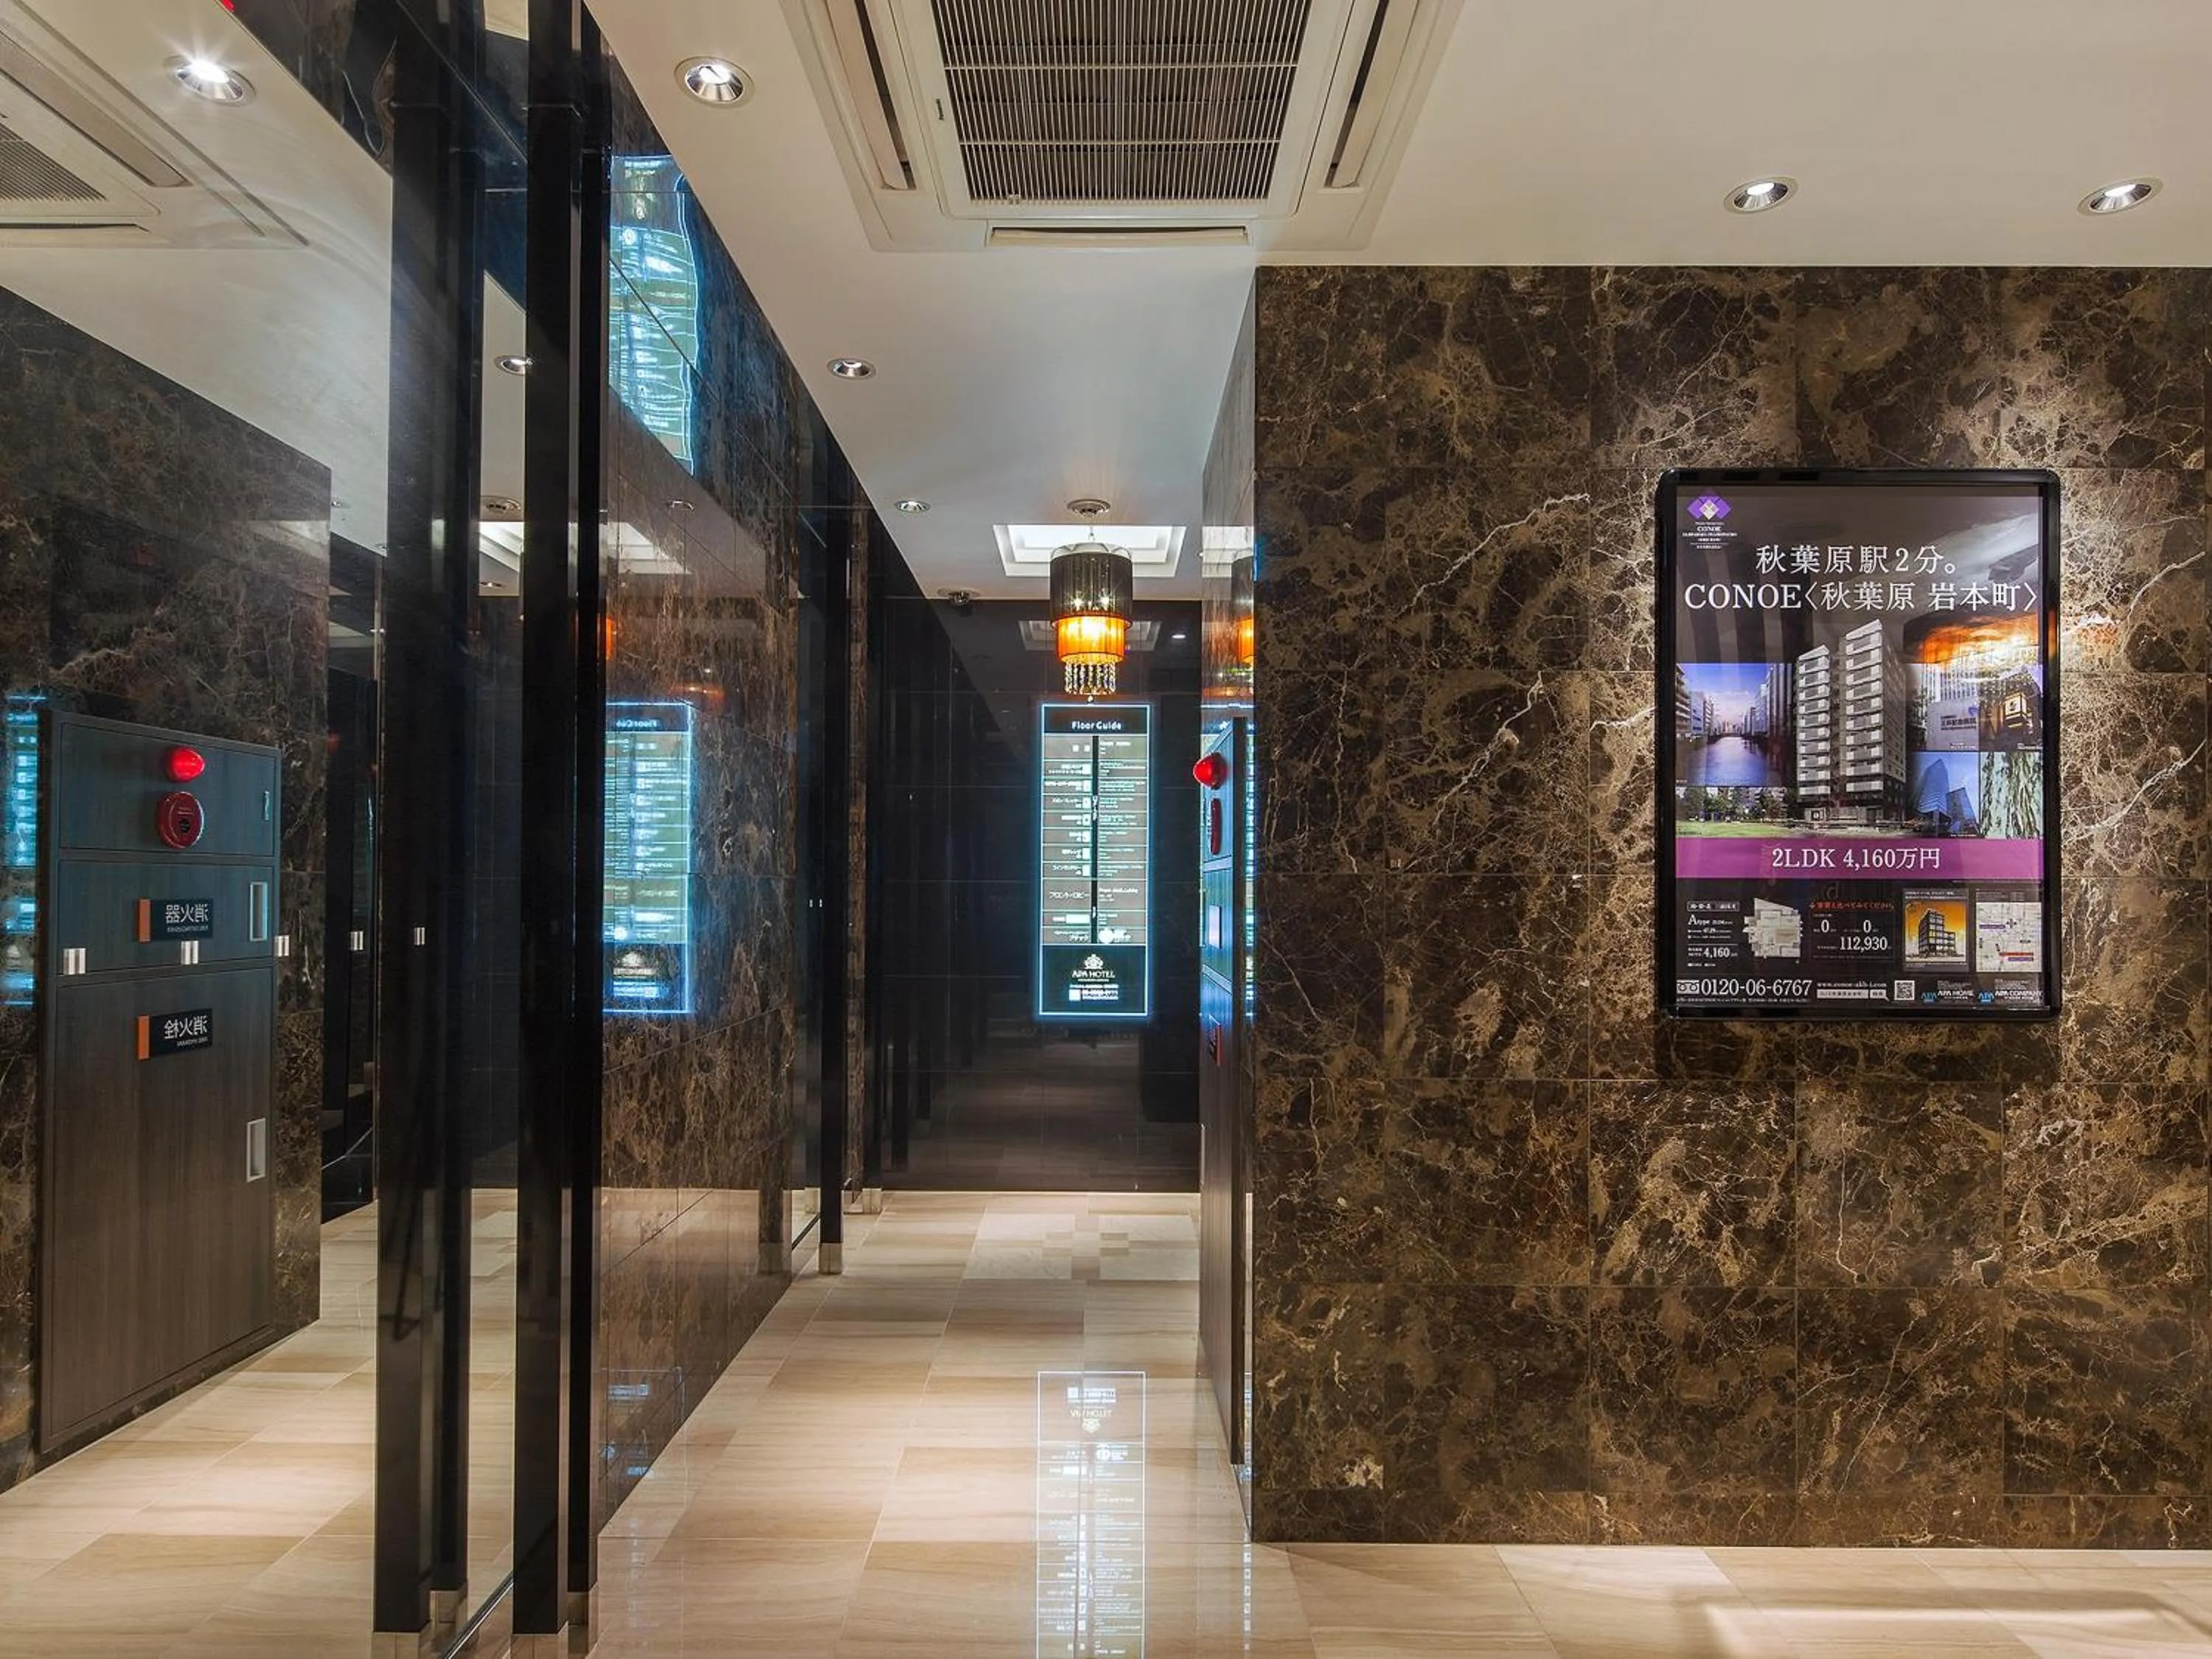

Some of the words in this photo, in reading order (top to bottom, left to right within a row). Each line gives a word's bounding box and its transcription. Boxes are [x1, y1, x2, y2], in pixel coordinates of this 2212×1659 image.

[1756, 543, 1957, 574] 秋葉原駅2分。
[1071, 720, 1095, 730] Floor
[1096, 720, 1121, 730] Guide
[1771, 847, 1836, 869] 2LDK
[1843, 847, 1941, 871] 4,160万円
[1820, 919, 1829, 933] 0
[1863, 919, 1871, 933] 0
[1840, 936, 1888, 953] 112,930
[1701, 978, 1812, 996] 0120-06-6767
